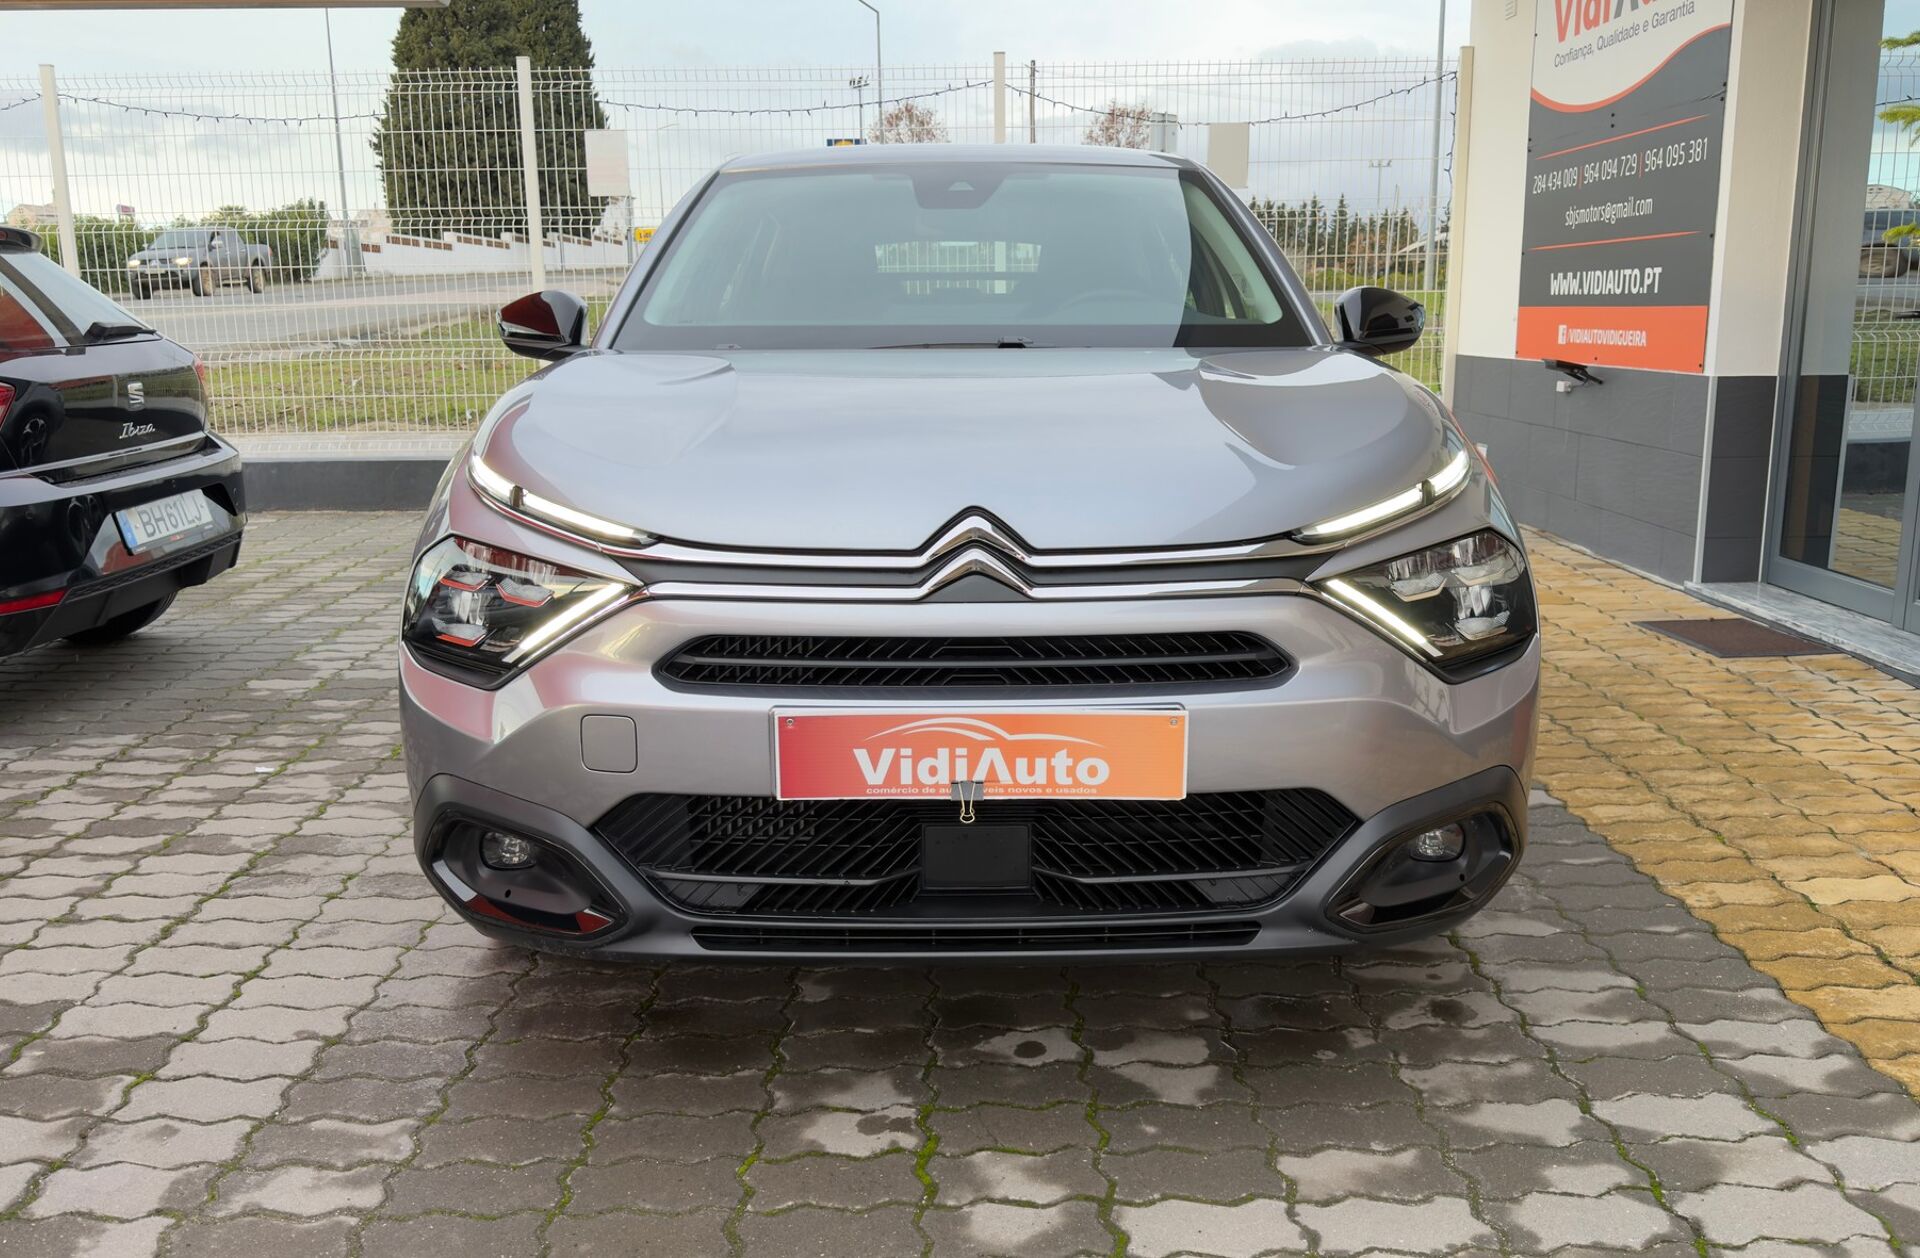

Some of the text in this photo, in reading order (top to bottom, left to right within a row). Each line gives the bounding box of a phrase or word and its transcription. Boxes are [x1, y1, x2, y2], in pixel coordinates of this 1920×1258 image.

[1554, 1, 1695, 68] Confiança, Qualidade e Garantia
[1532, 137, 1708, 194] 284 434 009 964 094 729 964 095 381
[1564, 197, 1653, 229] sbjsmotors@gmail.com
[1550, 267, 1662, 295] WWW.VIDIAUTO.PT
[119, 422, 156, 439] Ibiza
[853, 748, 1109, 785] VidiAuto
[866, 785, 919, 794] comércio
[922, 786, 936, 794] de
[1056, 786, 1097, 794] usados
